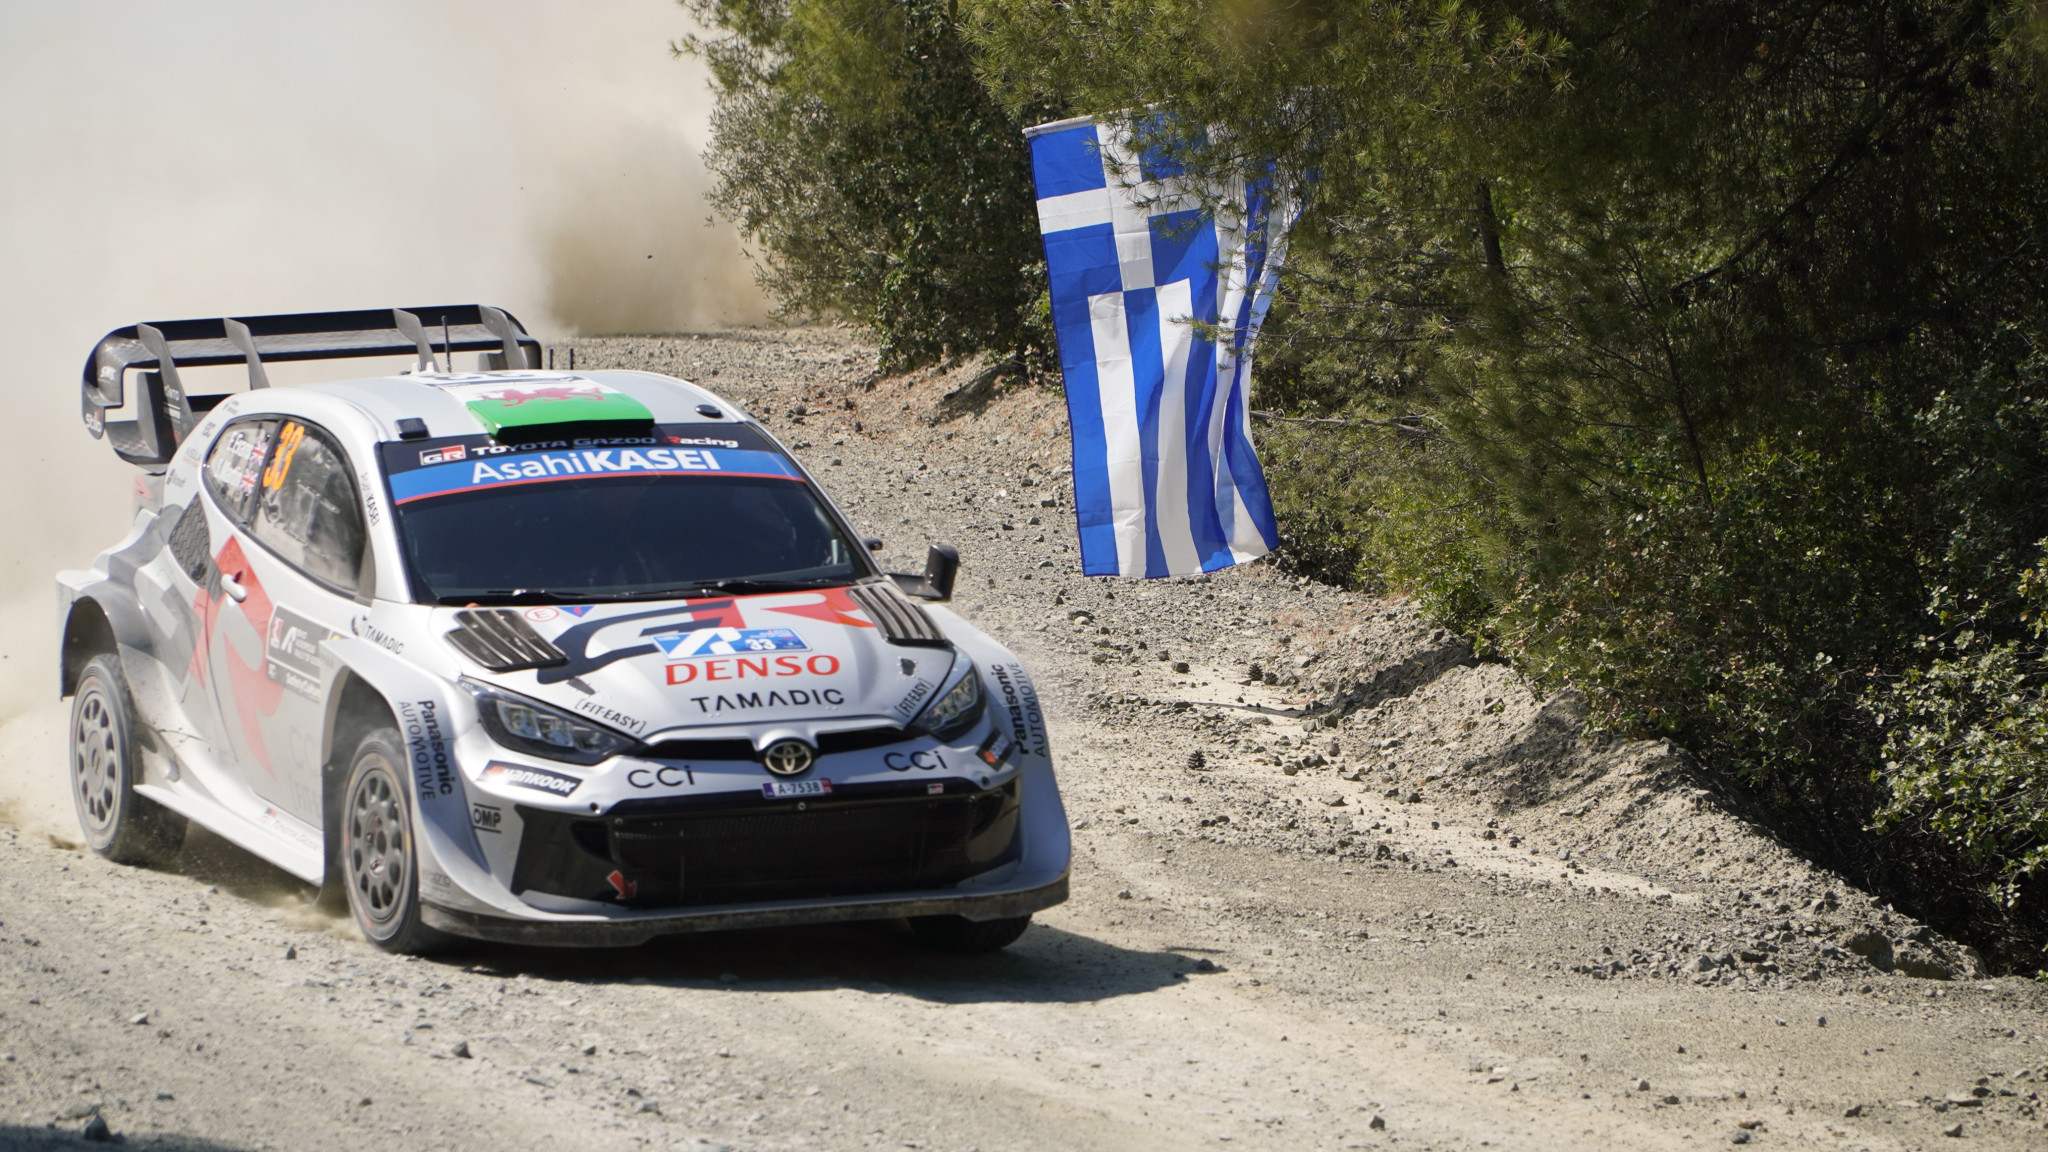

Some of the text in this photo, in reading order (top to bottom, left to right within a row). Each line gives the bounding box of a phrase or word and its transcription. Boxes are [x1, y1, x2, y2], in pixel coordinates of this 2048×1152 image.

[262, 421, 304, 491] 33
[471, 440, 567, 456] TOYOTA
[573, 437, 656, 446] GAZOO
[666, 436, 739, 448] Racing
[745, 638, 777, 650] 33
[664, 654, 840, 686] DENSO
[690, 688, 844, 713] TAMADIC
[991, 664, 1029, 755] Panasonic
[1006, 662, 1047, 758] AUTOMOTIVE
[398, 701, 436, 801] AUTOMOTIVE
[417, 700, 455, 796] Panasonic
[778, 780, 822, 795] A-7538
[473, 808, 501, 828] OMP
